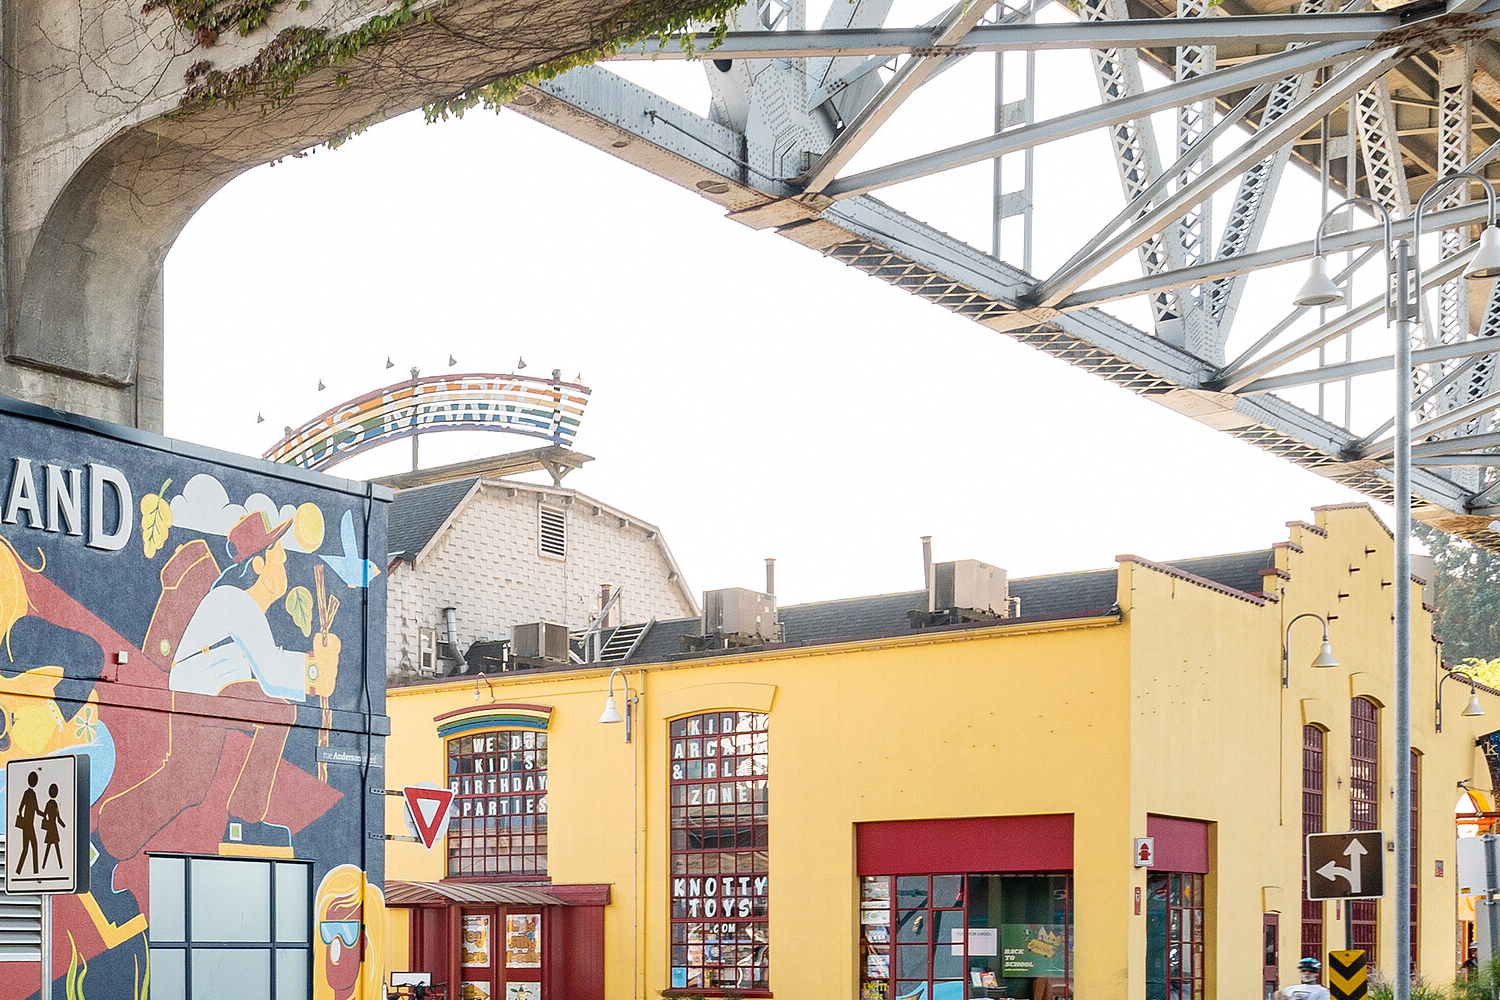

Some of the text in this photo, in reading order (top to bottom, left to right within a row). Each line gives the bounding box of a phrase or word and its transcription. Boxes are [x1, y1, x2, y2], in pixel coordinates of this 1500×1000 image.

[690, 718, 733, 735] KID
[472, 735, 535, 752] WE DO
[333, 751, 362, 762] Anderson
[672, 764, 684, 780] &
[451, 776, 547, 796] BIRTHDAY
[691, 786, 748, 804] ZONE
[463, 797, 547, 817] PARTIES
[674, 876, 767, 897] KNOTTY
[688, 898, 750, 918] TOYS
[709, 923, 736, 934] .COM
